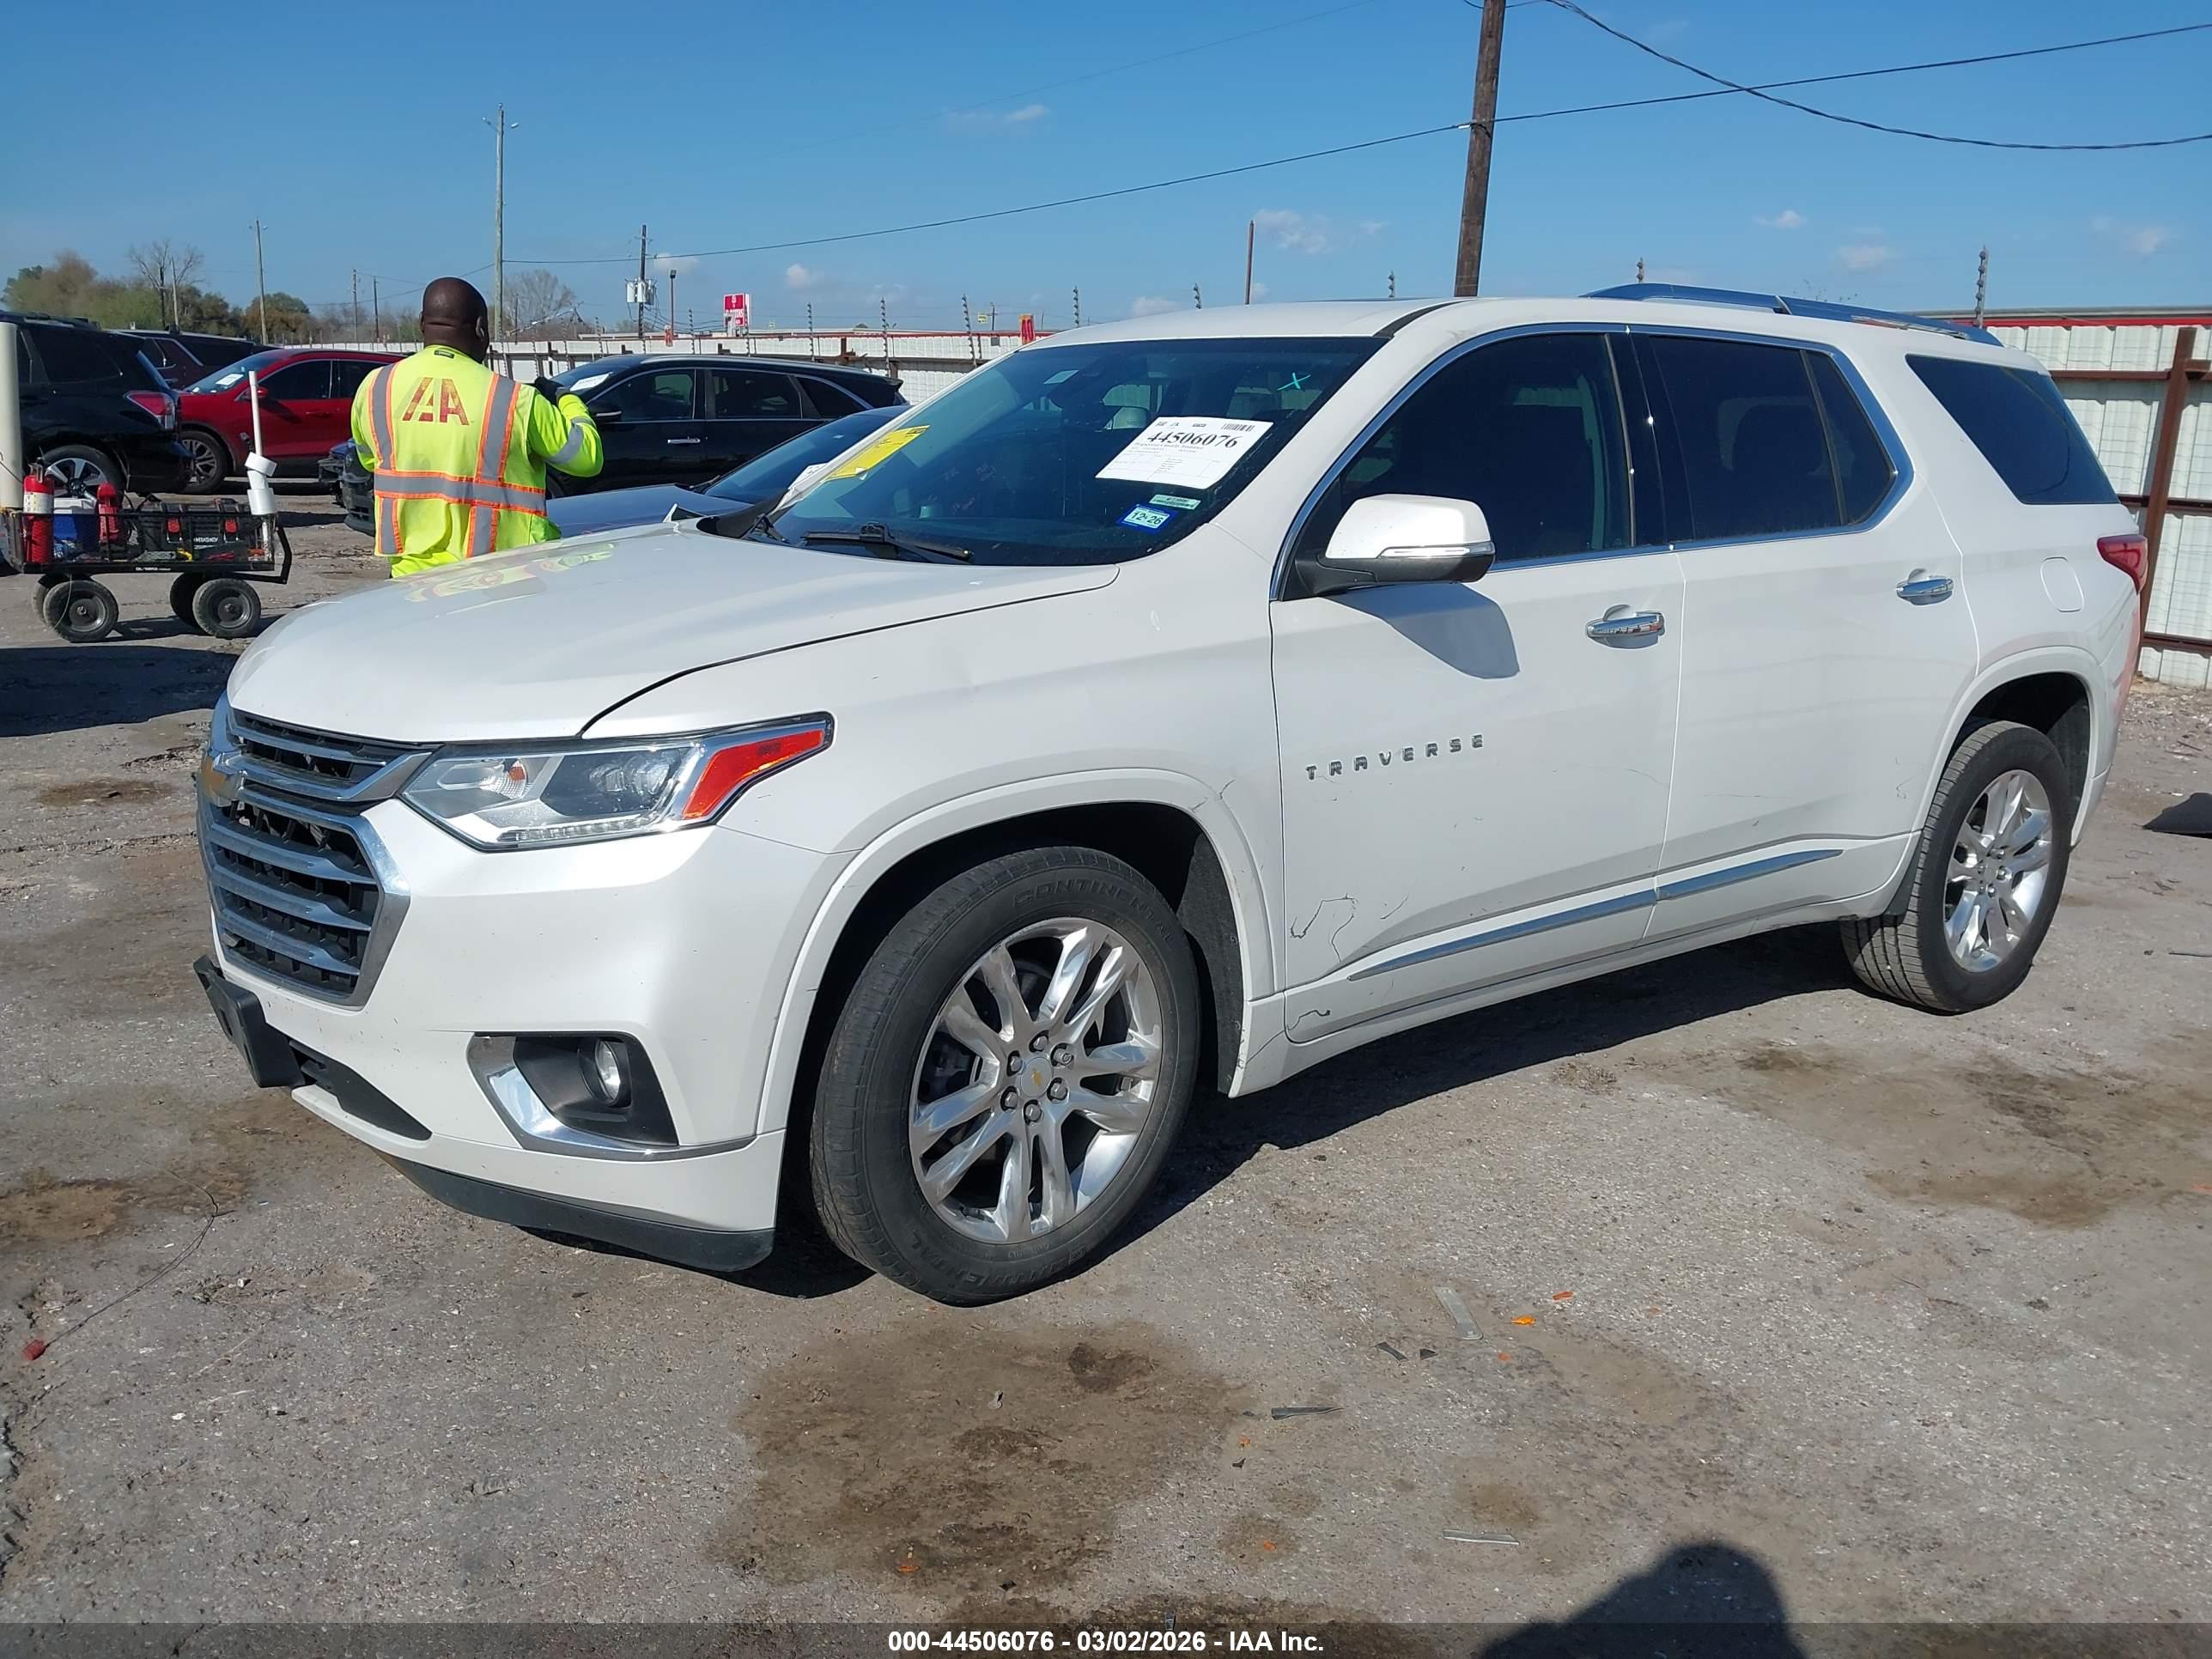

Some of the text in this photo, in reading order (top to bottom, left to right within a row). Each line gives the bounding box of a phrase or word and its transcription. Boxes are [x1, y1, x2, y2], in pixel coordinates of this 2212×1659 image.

[1146, 431, 1244, 448] 44506076
[1146, 515, 1164, 526] 26
[1305, 733, 1483, 781] TRAVERSE
